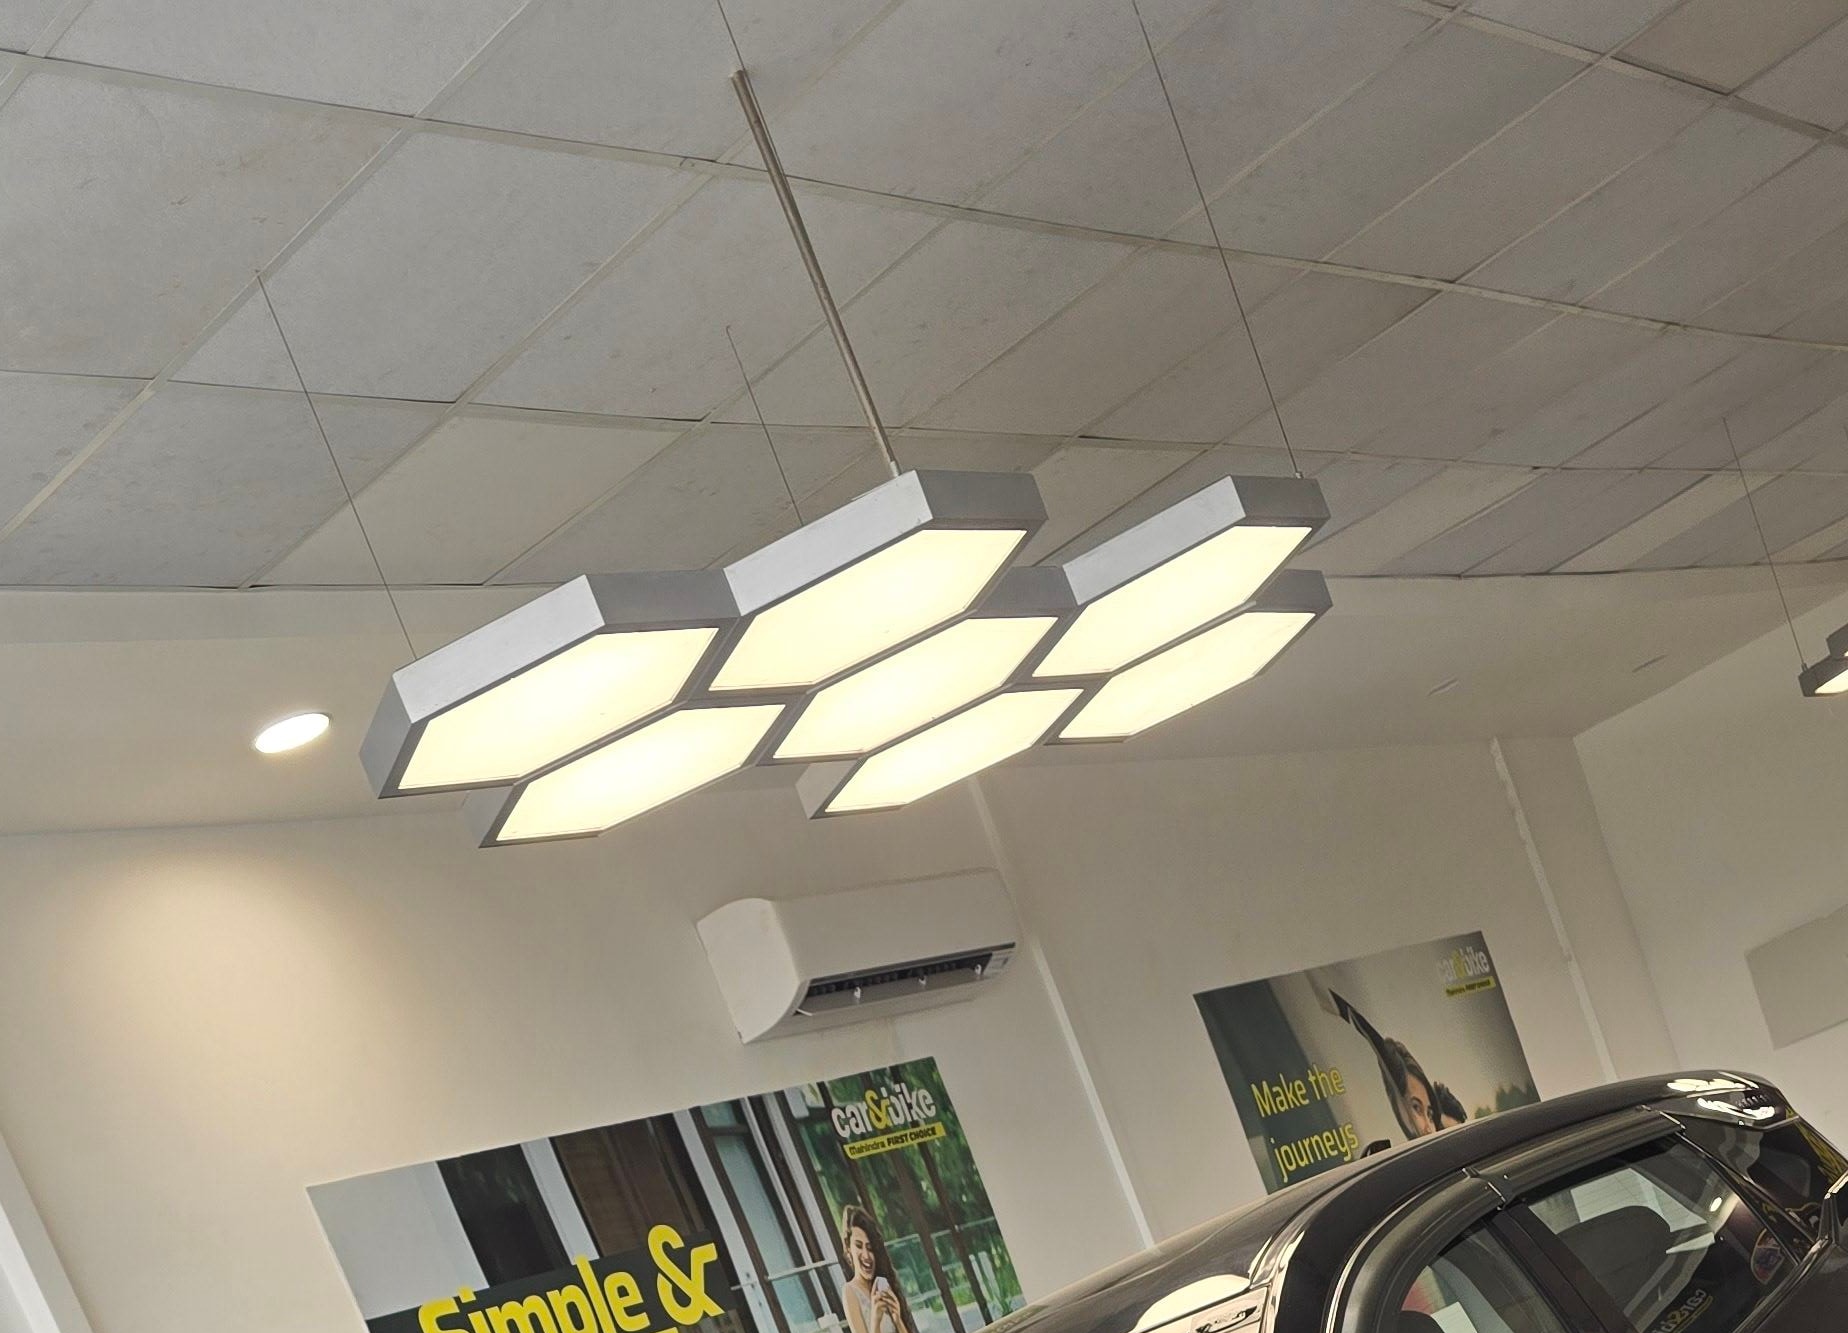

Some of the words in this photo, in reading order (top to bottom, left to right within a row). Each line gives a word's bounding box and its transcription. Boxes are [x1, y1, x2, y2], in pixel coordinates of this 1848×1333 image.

[831, 1083, 936, 1138] car&bike
[1251, 1073, 1309, 1118] Make
[1307, 1064, 1345, 1100] the
[848, 1141, 886, 1155] Mahindra
[887, 1134, 908, 1146] FIRST
[909, 1126, 937, 1141] CHOICE
[1270, 1124, 1359, 1183] journeys
[648, 1224, 725, 1325] &
